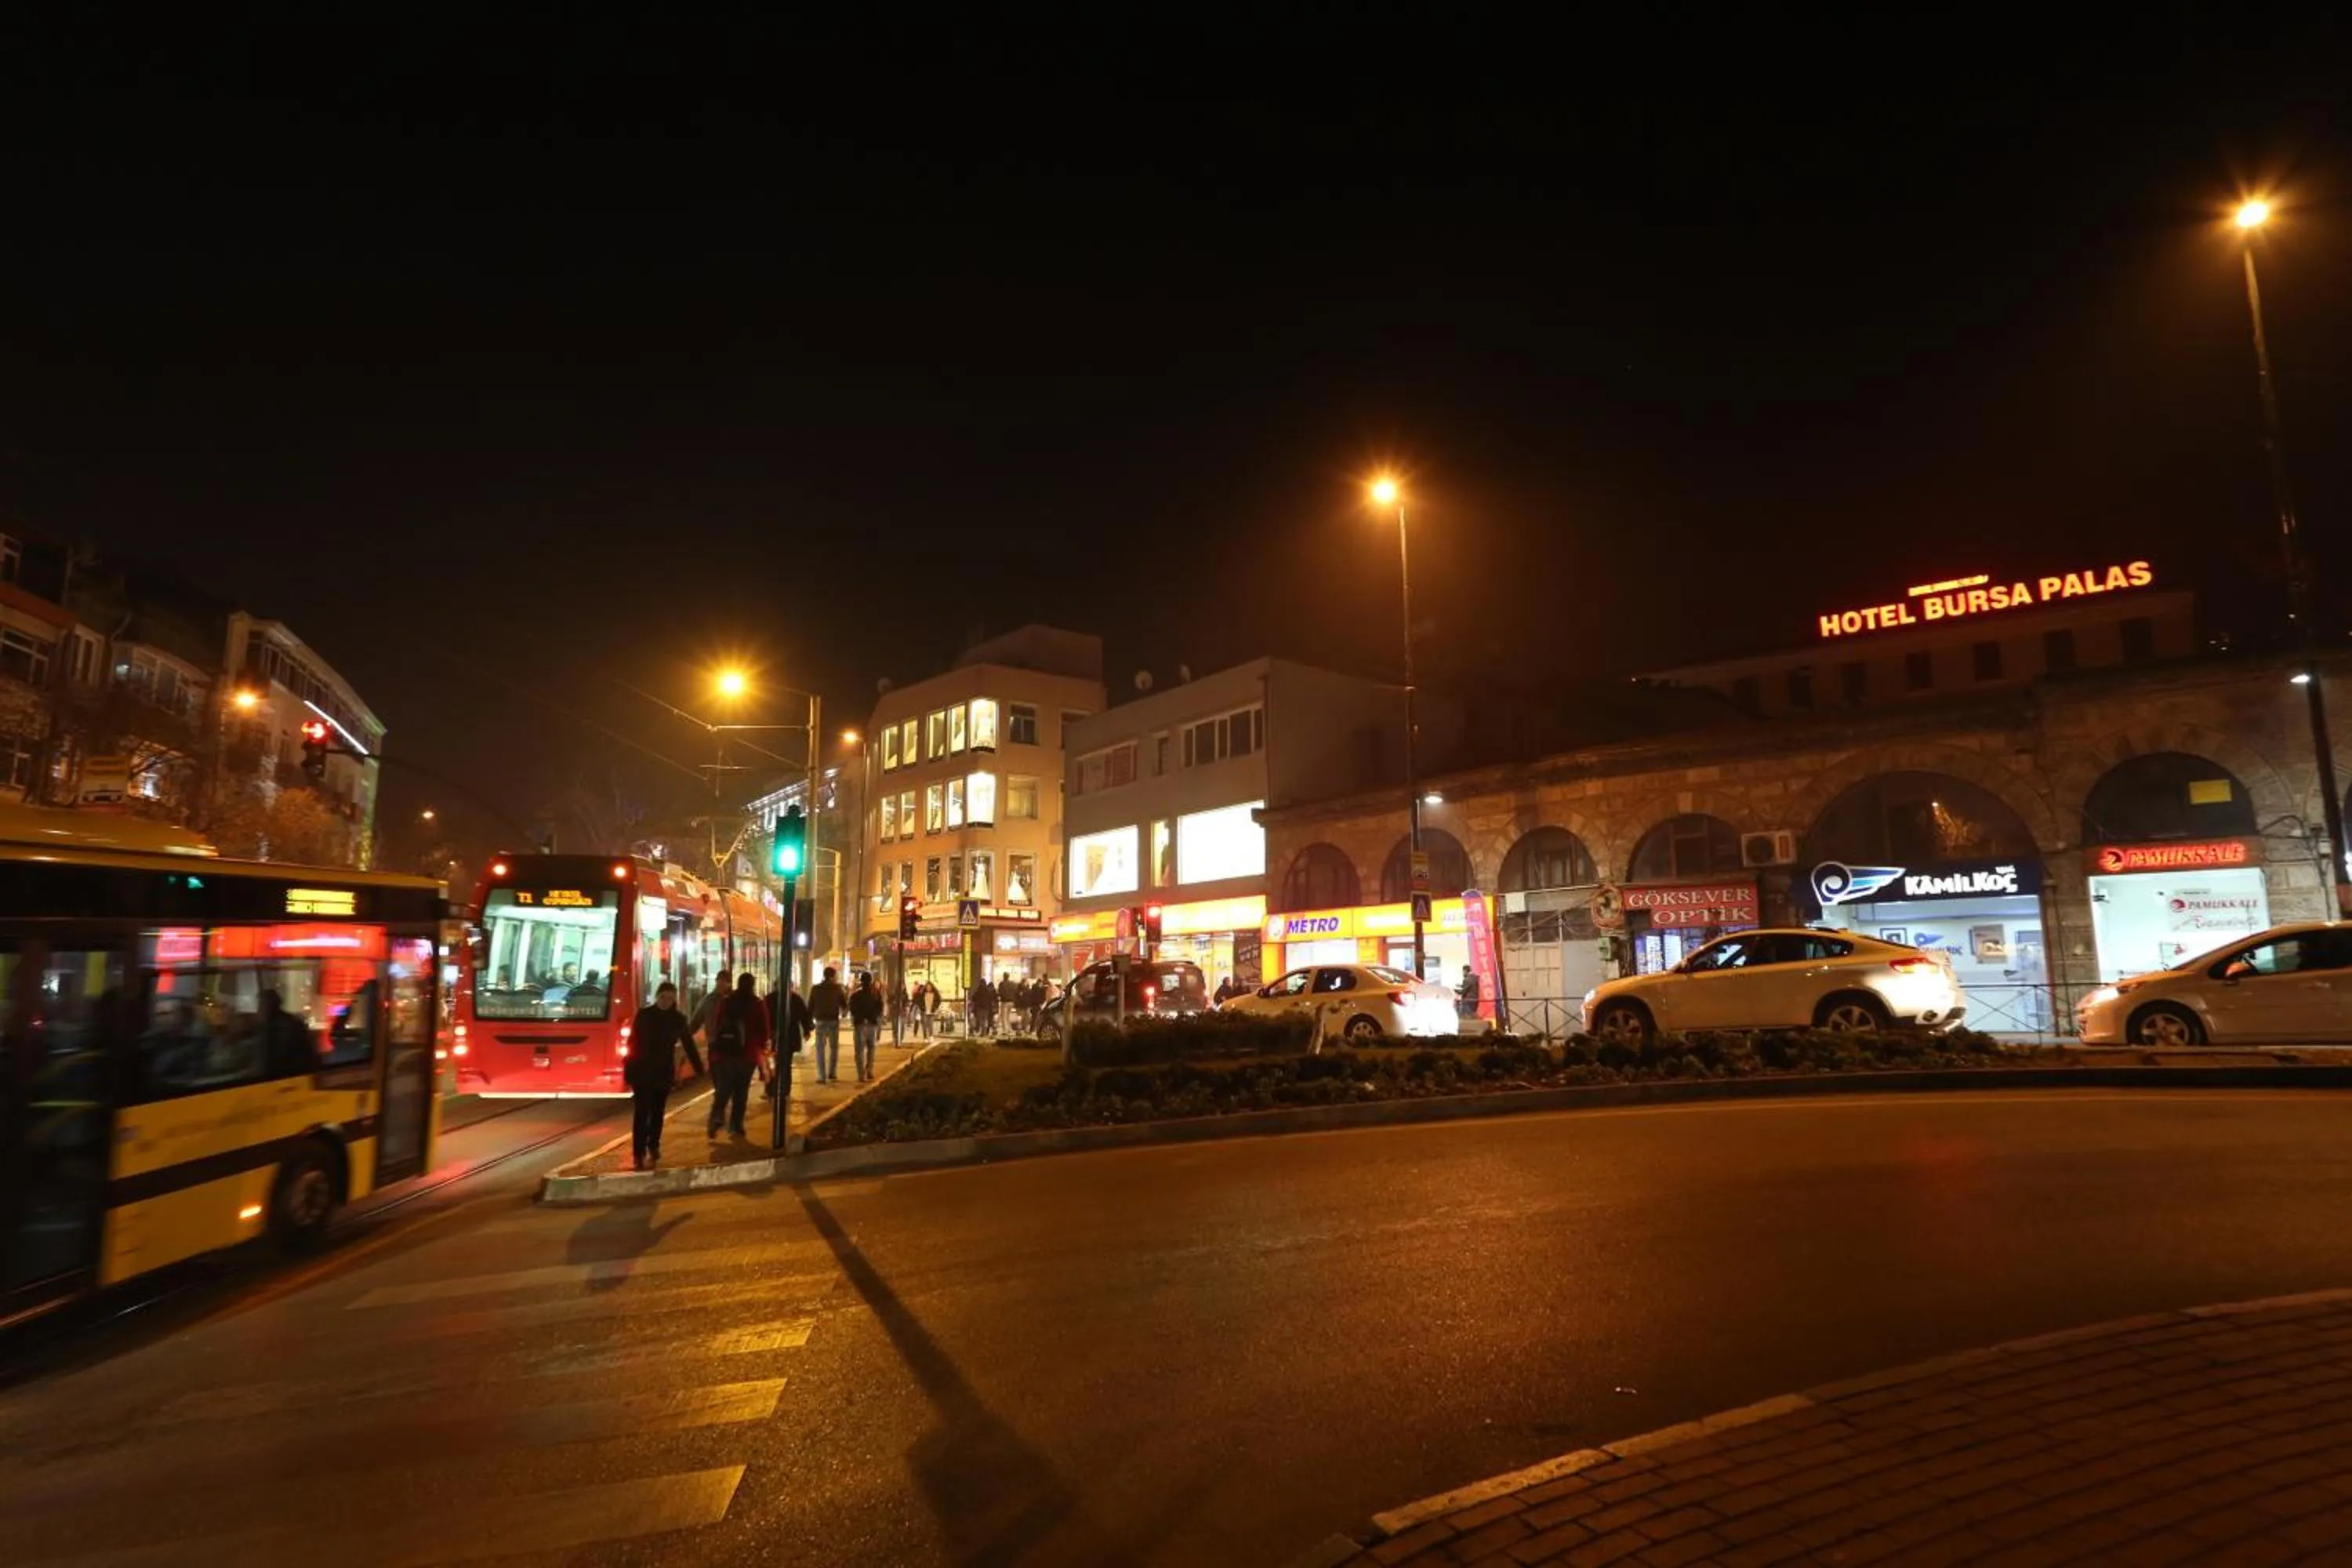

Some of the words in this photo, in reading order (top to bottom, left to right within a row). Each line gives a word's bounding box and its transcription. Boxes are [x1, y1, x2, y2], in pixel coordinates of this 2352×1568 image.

[1820, 604, 1915, 637] HOTEL
[1924, 583, 2033, 620] BURSA
[2040, 561, 2152, 601] PALAS
[2128, 841, 2245, 866] PAMUKKALE
[1628, 888, 1751, 907] GÖKSEVER
[1653, 906, 1755, 924] OPTİK
[1287, 916, 1340, 934] METRO
